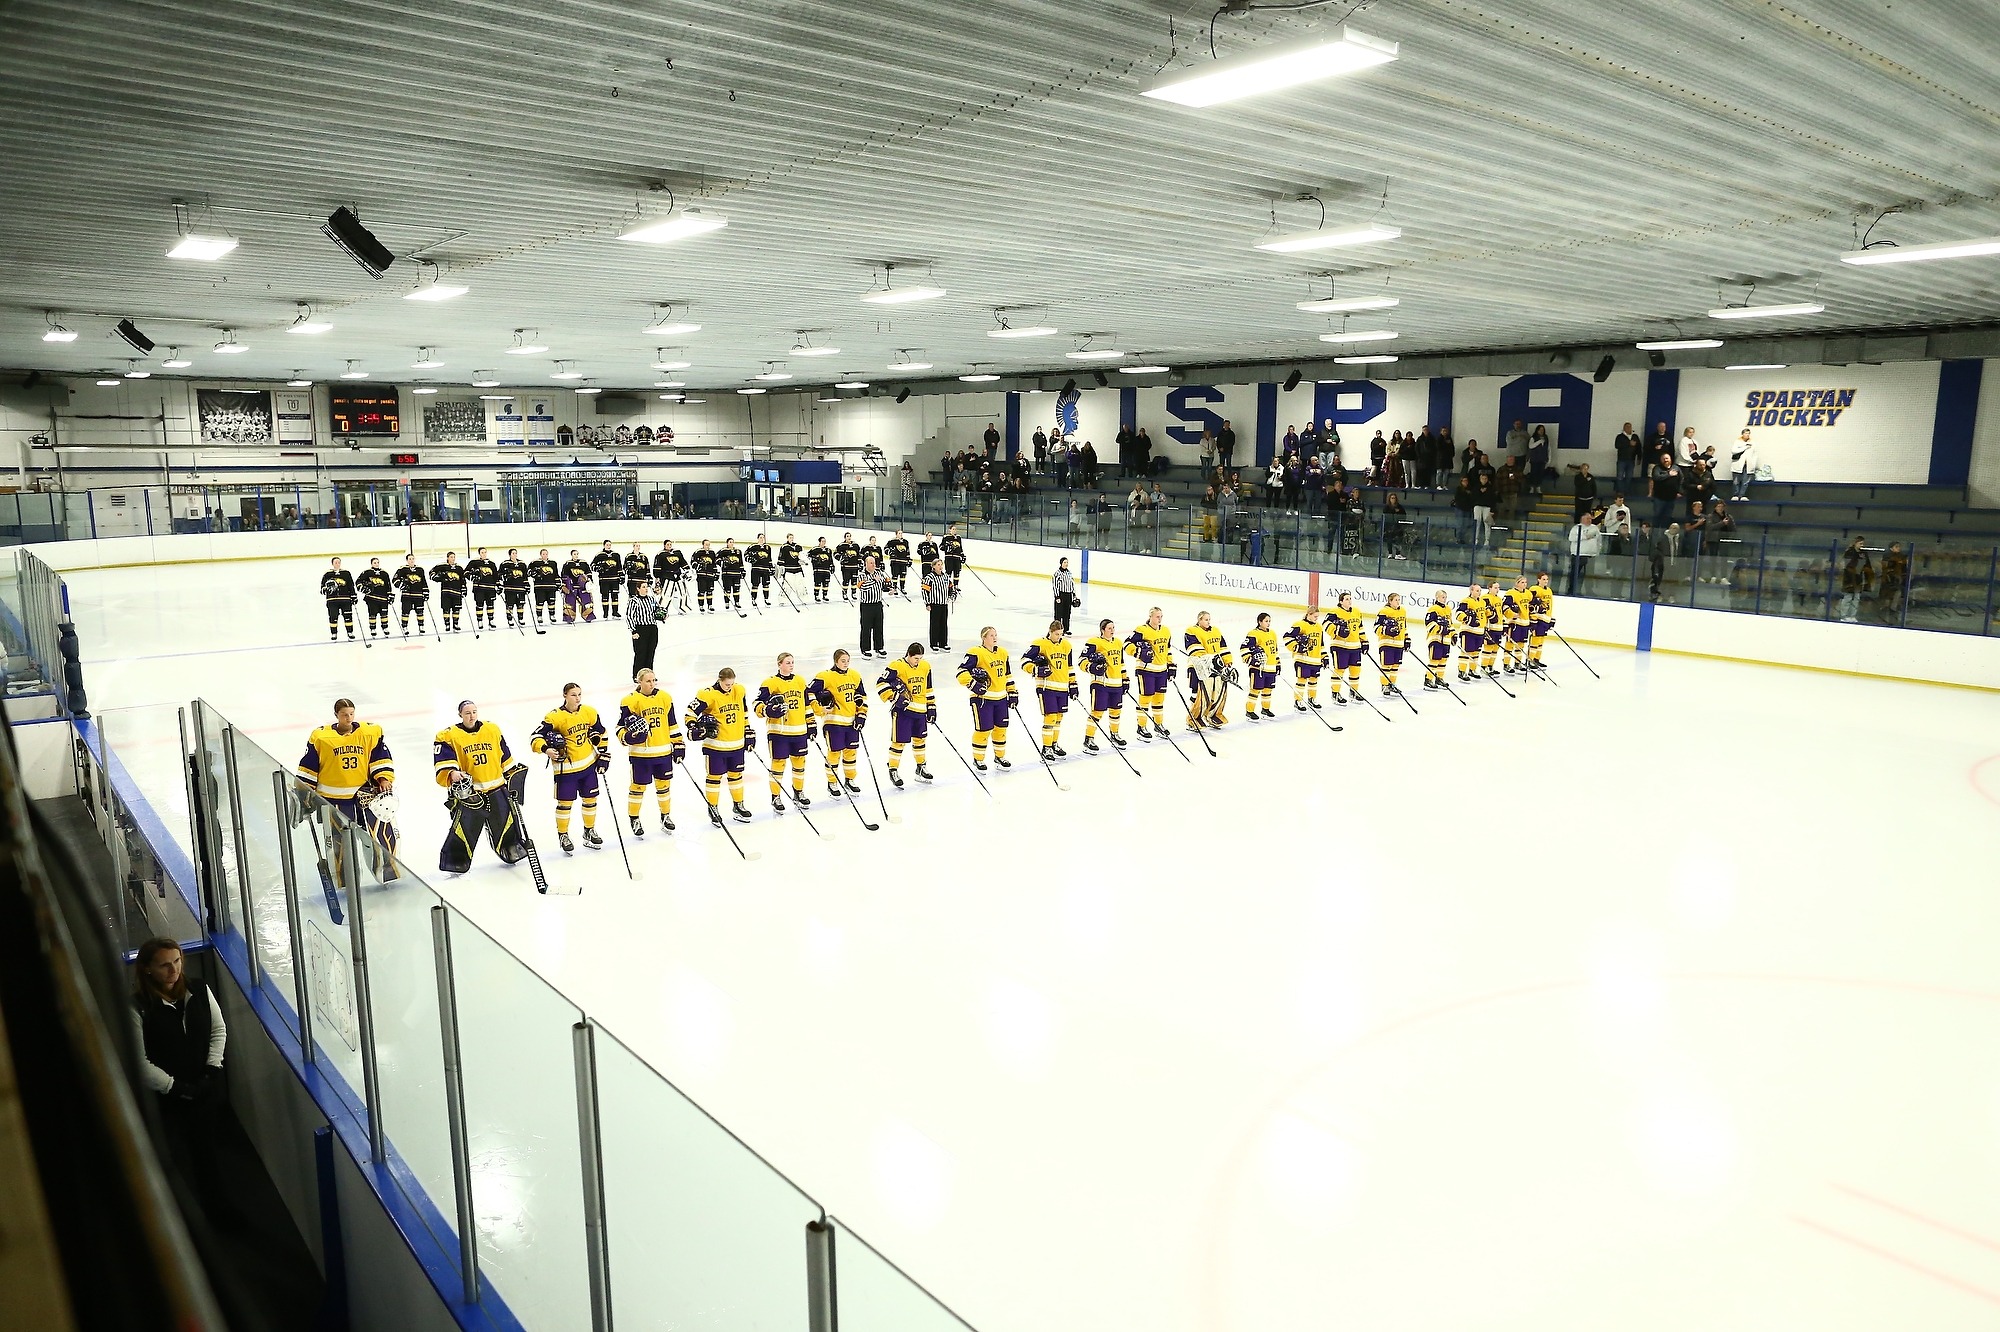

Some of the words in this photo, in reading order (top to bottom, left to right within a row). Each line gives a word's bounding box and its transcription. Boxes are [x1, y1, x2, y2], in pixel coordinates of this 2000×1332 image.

[1744, 388, 1856, 408] SPARTAN
[1166, 386, 1225, 444] S
[1314, 380, 1387, 435] P
[1497, 373, 1593, 449] A
[1746, 408, 1843, 427] HOCKEY
[342, 420, 349, 432] 0
[391, 421, 398, 432] 0
[1247, 577, 1301, 595] ACADEMY
[1354, 586, 1407, 605] SUMMT
[912, 684, 922, 695] 20
[844, 692, 853, 702] 21
[788, 699, 799, 710] 22
[649, 717, 661, 728] 26
[726, 712, 736, 725] 23
[576, 732, 589, 746] 27
[332, 746, 365, 757] WILDCATS
[462, 743, 493, 755] WILDCATS
[342, 756, 358, 770] 33
[472, 753, 488, 766] 30
[527, 847, 546, 890] WARRIOR
